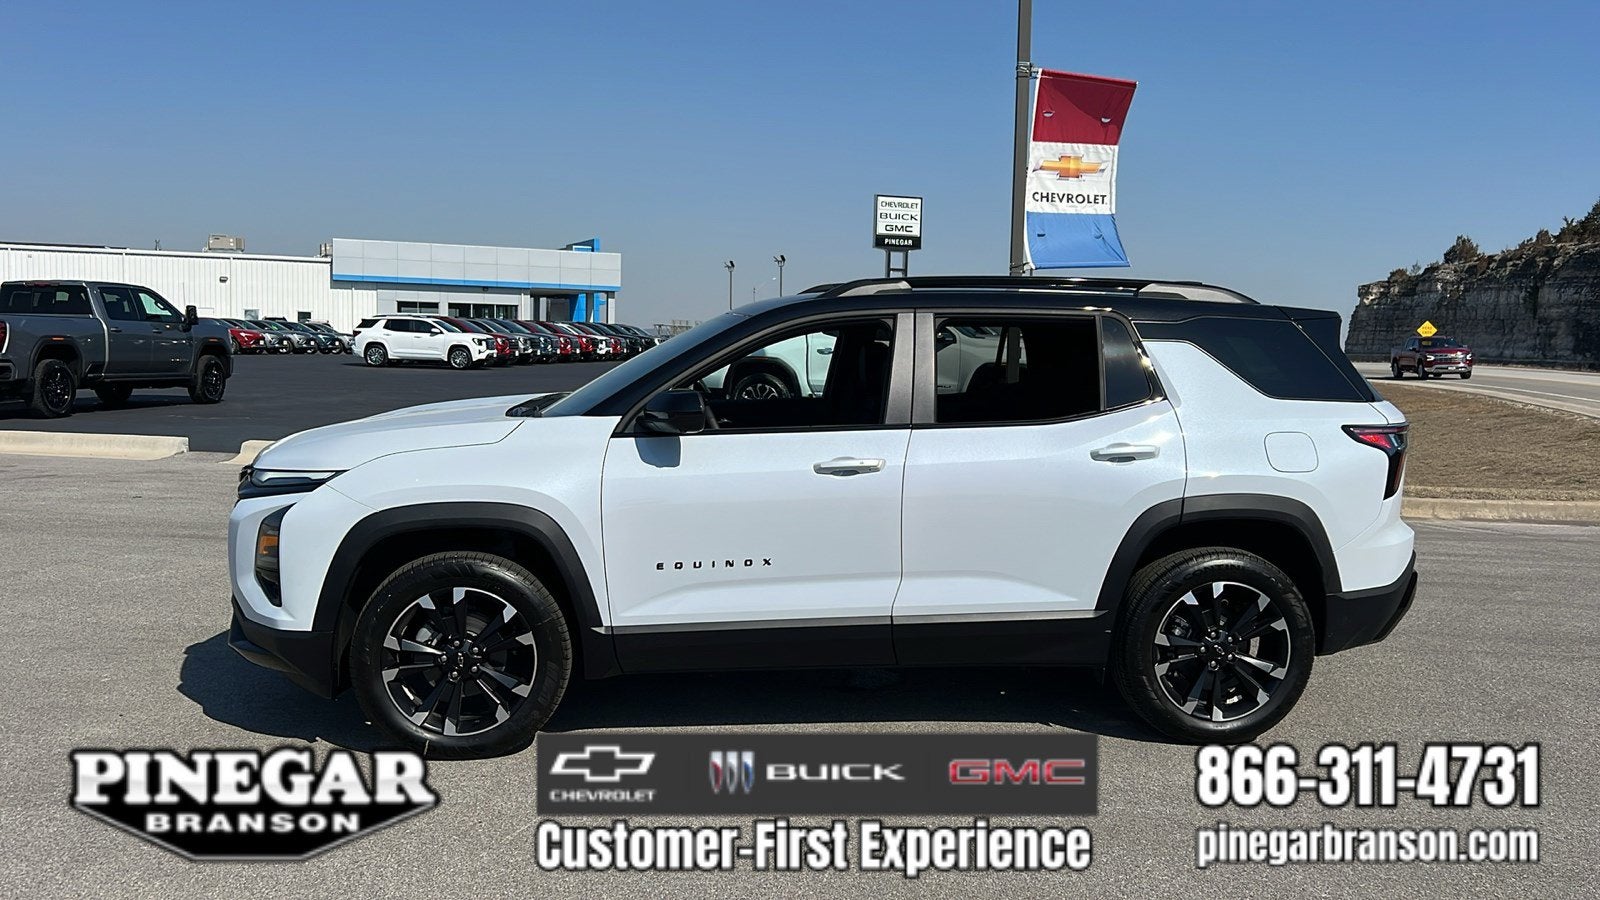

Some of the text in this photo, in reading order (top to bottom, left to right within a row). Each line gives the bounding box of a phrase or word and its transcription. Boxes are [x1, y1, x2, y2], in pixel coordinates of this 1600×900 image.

[1032, 191, 1107, 205] CHEVROLET
[880, 200, 919, 210] CHEVROLET
[879, 212, 919, 221] BUICK
[884, 224, 913, 233] GMC
[884, 238, 913, 246] PINEGAR
[656, 558, 773, 571] EQUINOX
